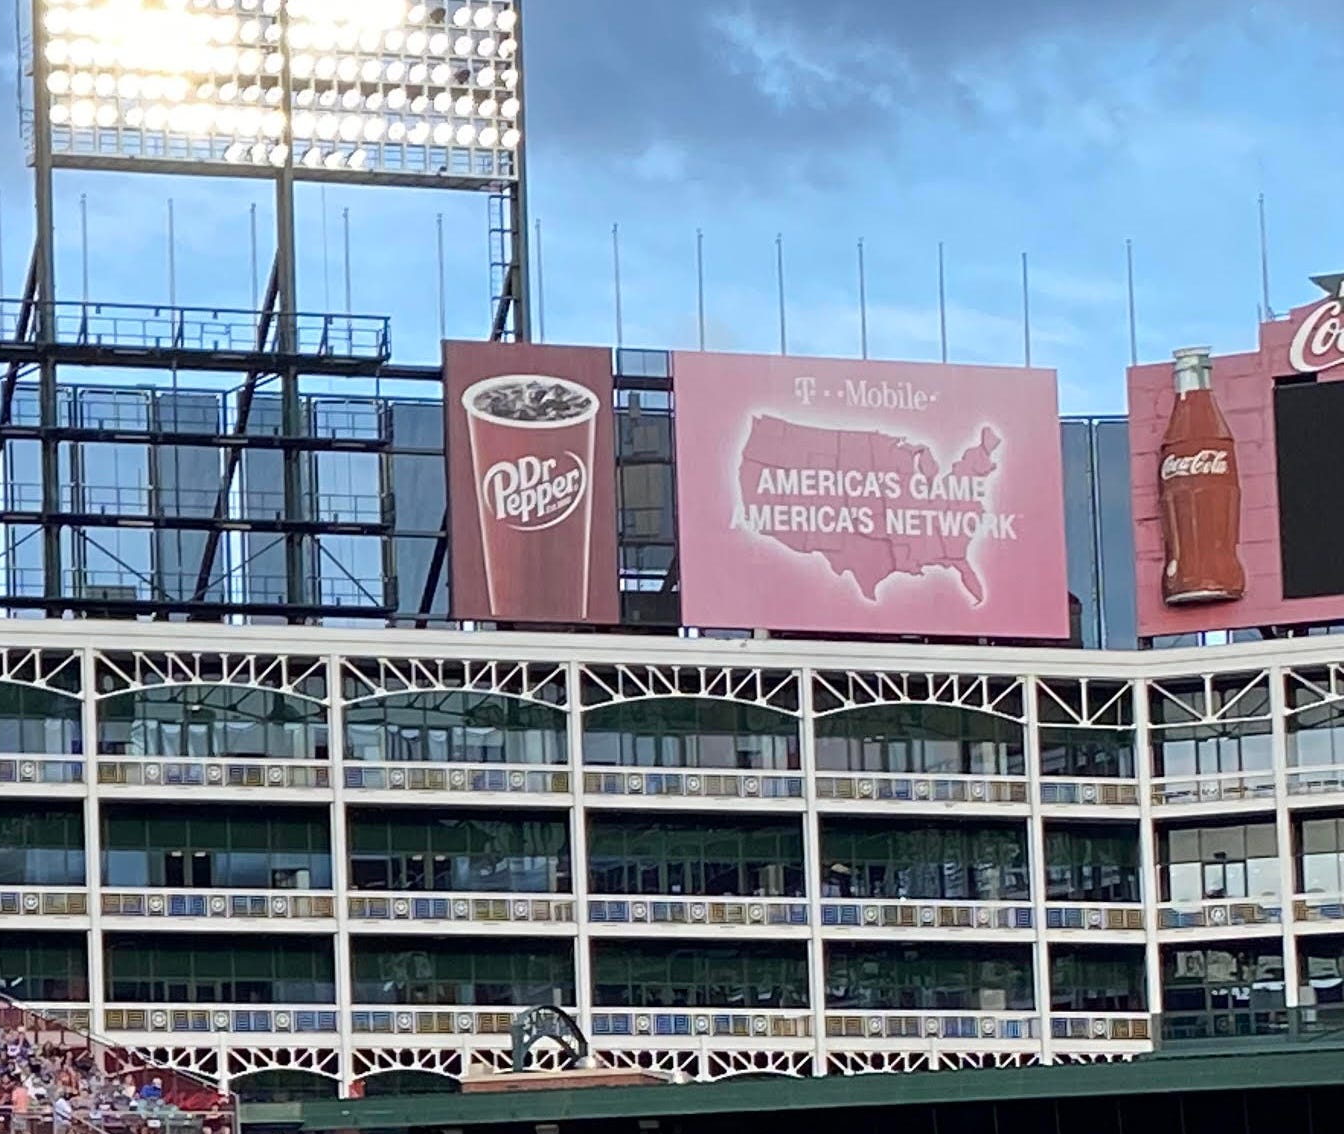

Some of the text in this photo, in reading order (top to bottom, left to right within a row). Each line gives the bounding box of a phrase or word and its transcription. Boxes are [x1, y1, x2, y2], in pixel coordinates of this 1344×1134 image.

[518, 455, 557, 489] Dr
[757, 467, 986, 501] AMERICA'S GAME
[483, 461, 580, 523] Pepper
[729, 504, 1016, 539] AMERICA'S NETWORK
